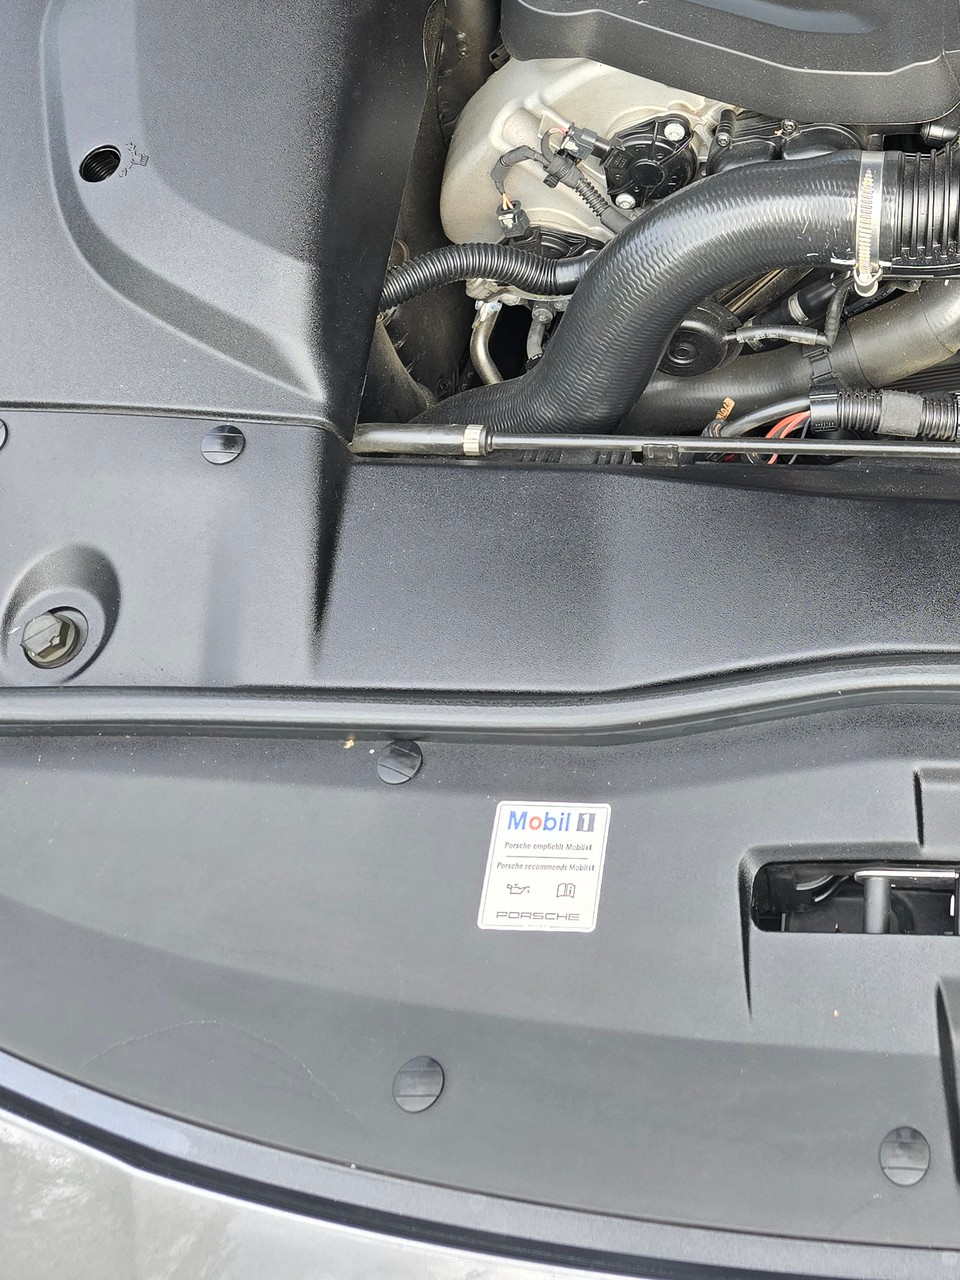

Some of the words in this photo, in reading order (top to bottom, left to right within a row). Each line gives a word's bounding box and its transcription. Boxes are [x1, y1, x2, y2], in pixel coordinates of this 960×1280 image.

[507, 810, 572, 832] Mobil
[504, 841, 532, 850] Porsche
[533, 843, 564, 852] empfiehlt
[496, 861, 524, 870] Porsche
[525, 863, 568, 872] recommends
[495, 911, 581, 921] PORSCHE
